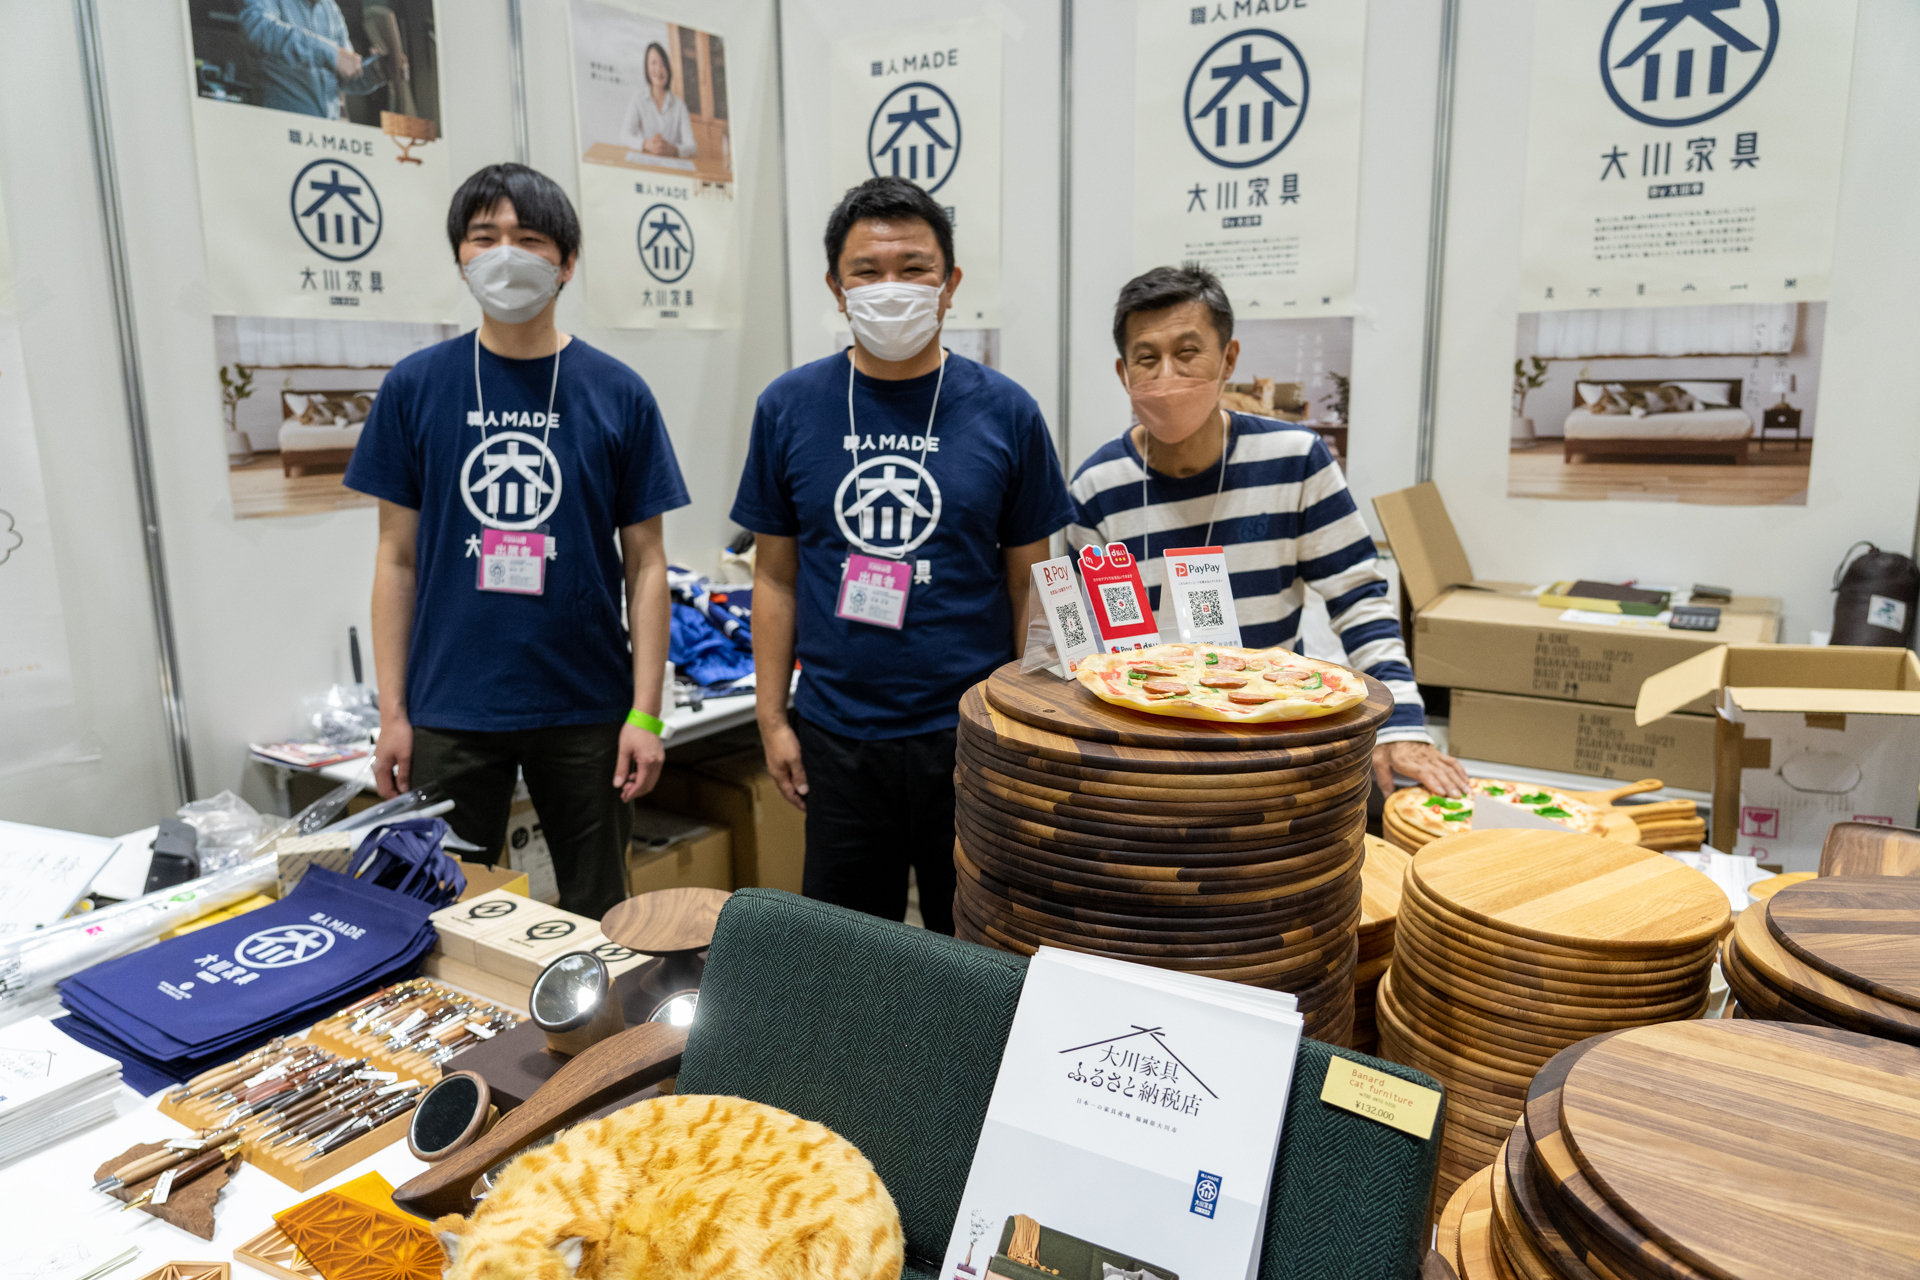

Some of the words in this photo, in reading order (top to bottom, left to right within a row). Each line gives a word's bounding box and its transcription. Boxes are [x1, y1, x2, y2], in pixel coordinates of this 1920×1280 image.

[1601, 131, 1760, 182] 大川家具
[1187, 173, 1301, 214] 大川家具
[300, 266, 385, 294] 大川家具
[466, 410, 560, 429] 職人MADE
[842, 434, 940, 453] 職人MADE
[1188, 563, 1220, 575] PayPay
[1099, 1045, 1179, 1084] 大川家具
[1351, 1068, 1385, 1087] Banard
[1067, 1061, 1203, 1117] ふるさと納税店
[1349, 1079, 1364, 1090] cat
[1369, 1084, 1414, 1107] furniture
[1355, 1100, 1395, 1121] ¥132,000
